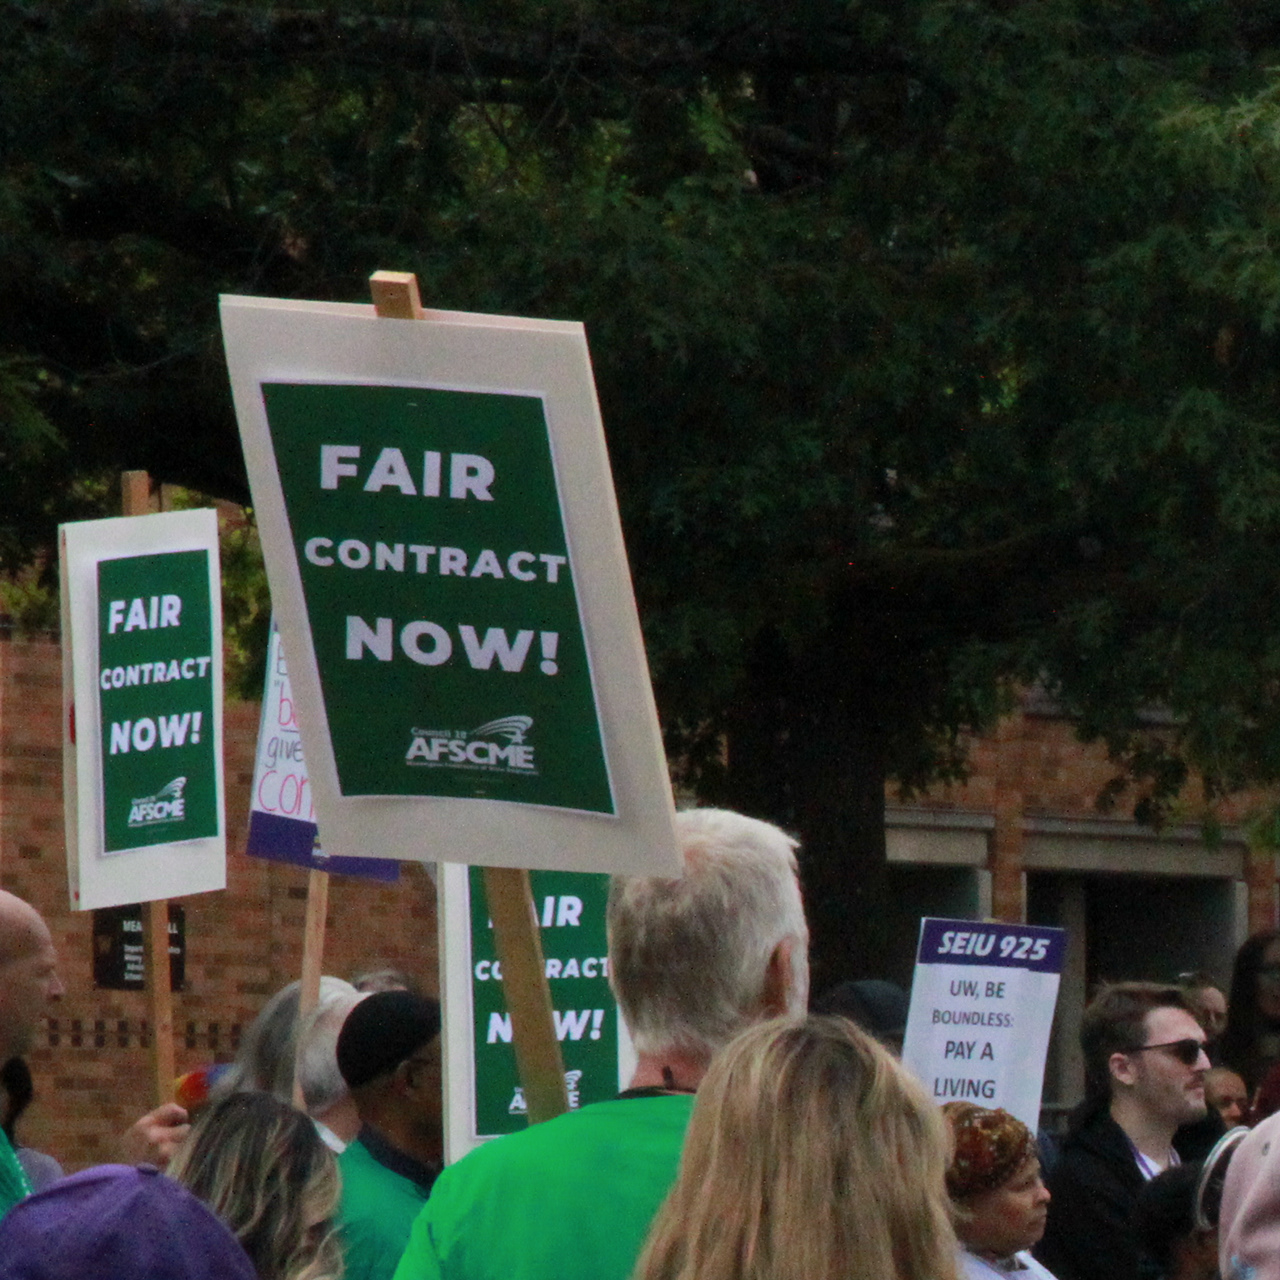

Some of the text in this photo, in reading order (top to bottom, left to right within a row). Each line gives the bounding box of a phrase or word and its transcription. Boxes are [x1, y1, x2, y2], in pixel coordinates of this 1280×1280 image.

[320, 444, 495, 501] FAIR
[304, 537, 566, 583] CONTRACT
[108, 594, 182, 634] FAIR
[345, 615, 559, 676] NOW!
[100, 656, 211, 690] CONTRACT
[109, 712, 202, 755] NOW!
[405, 737, 535, 769] AFSCME
[128, 799, 185, 823] AFSCME
[488, 896, 583, 928] IR
[937, 931, 1051, 961] SEIU 925
[474, 957, 609, 981] CORACT
[950, 980, 1005, 1000] UW, BE
[486, 1009, 604, 1044] NW!
[932, 1009, 1014, 1028] BOUNDLESS:
[944, 1041, 994, 1060] PAY A
[933, 1077, 996, 1099] LIVING
